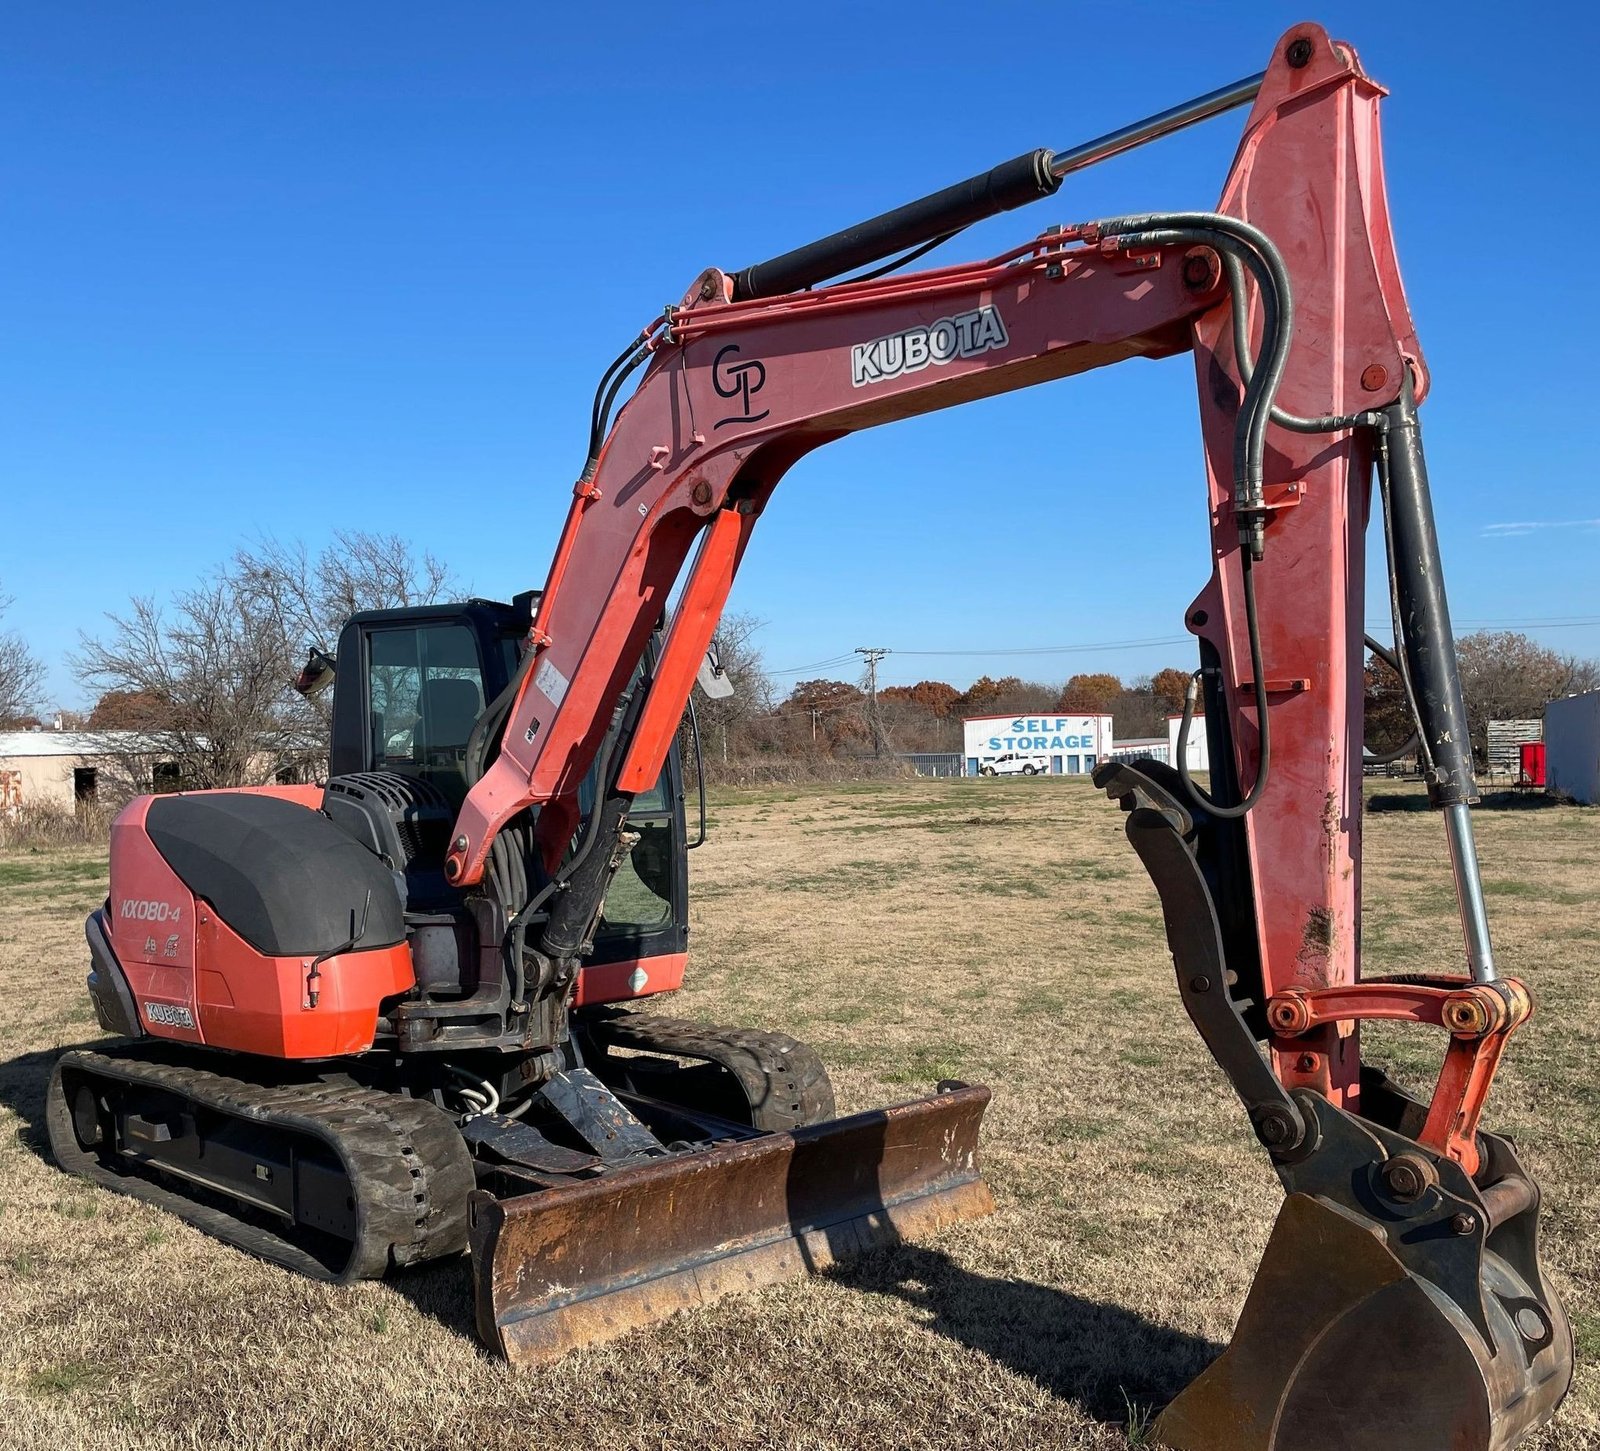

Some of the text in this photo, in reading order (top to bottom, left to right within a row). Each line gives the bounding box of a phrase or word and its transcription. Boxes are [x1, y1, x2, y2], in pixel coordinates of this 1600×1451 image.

[852, 305, 1008, 387] KUBOTA
[1011, 718, 1068, 733] SELF
[988, 735, 1094, 751] STORAGE
[145, 1002, 196, 1030] KUBOTA
